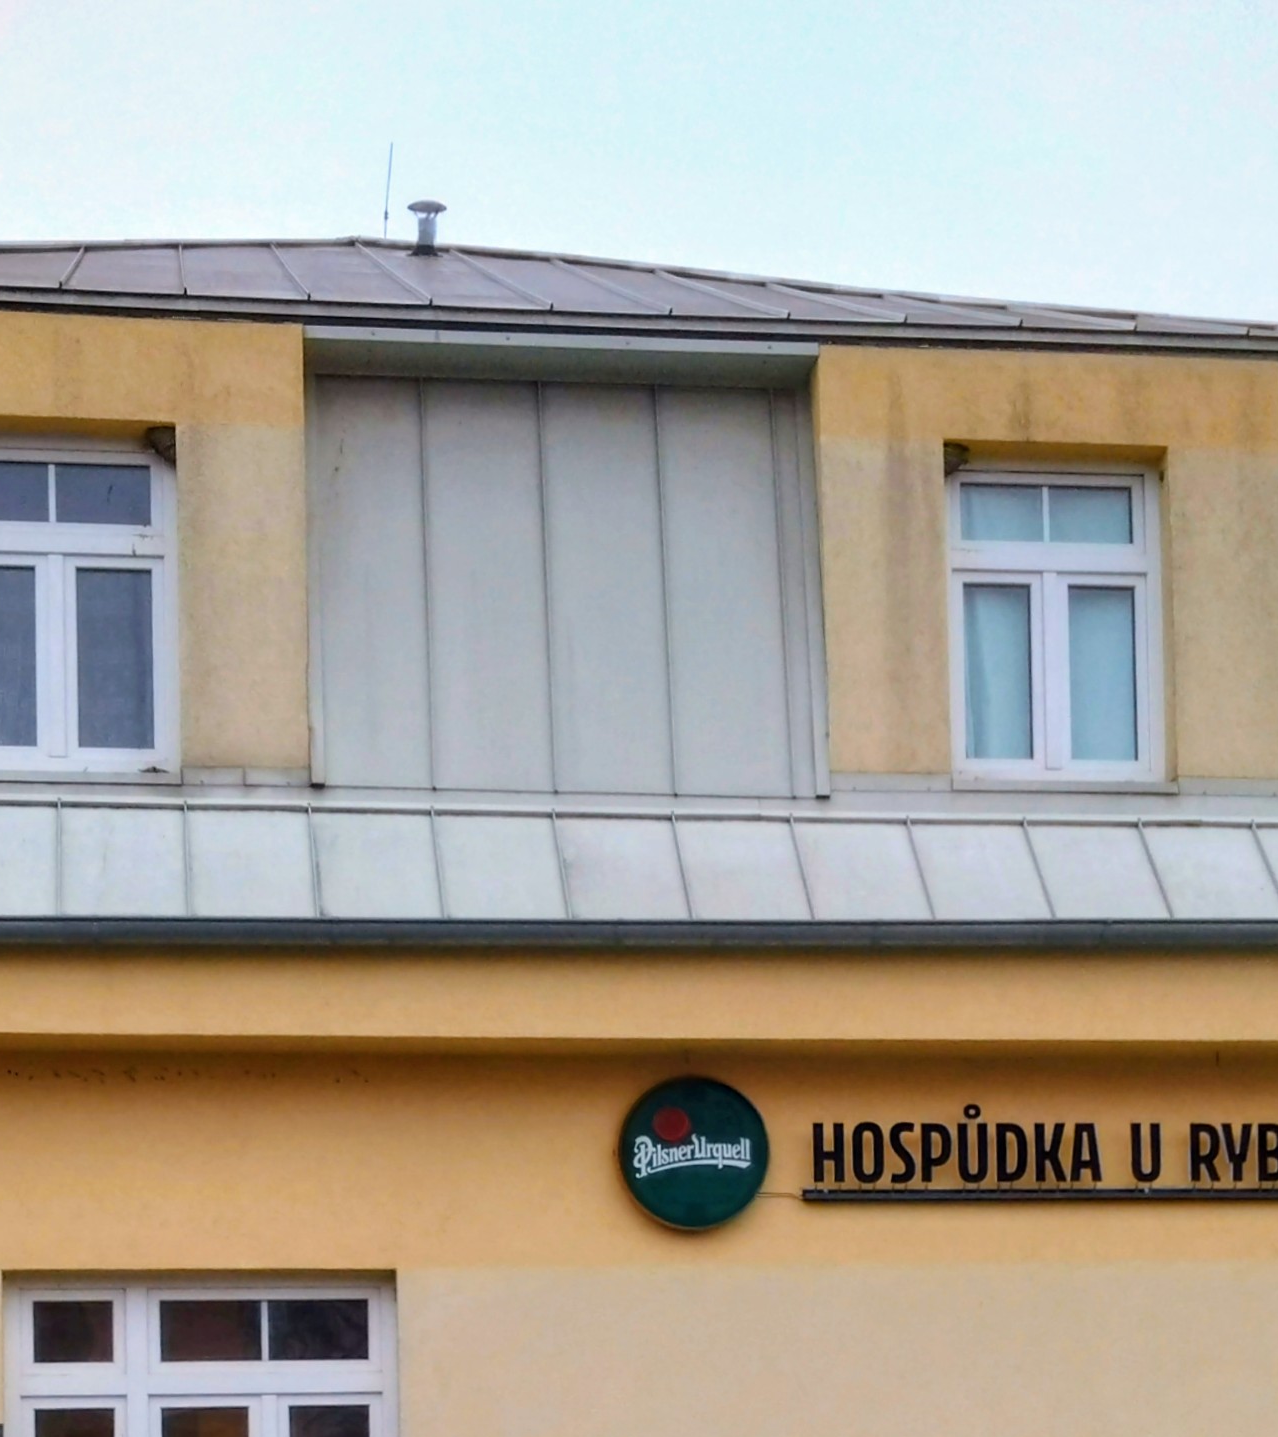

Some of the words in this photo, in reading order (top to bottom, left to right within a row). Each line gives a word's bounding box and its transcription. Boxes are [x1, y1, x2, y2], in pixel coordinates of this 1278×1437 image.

[633, 1135, 695, 1178] Pilsner
[692, 1133, 751, 1169] Urquell
[812, 1104, 1102, 1183] HOSPŮDKA
[1131, 1123, 1161, 1183] U
